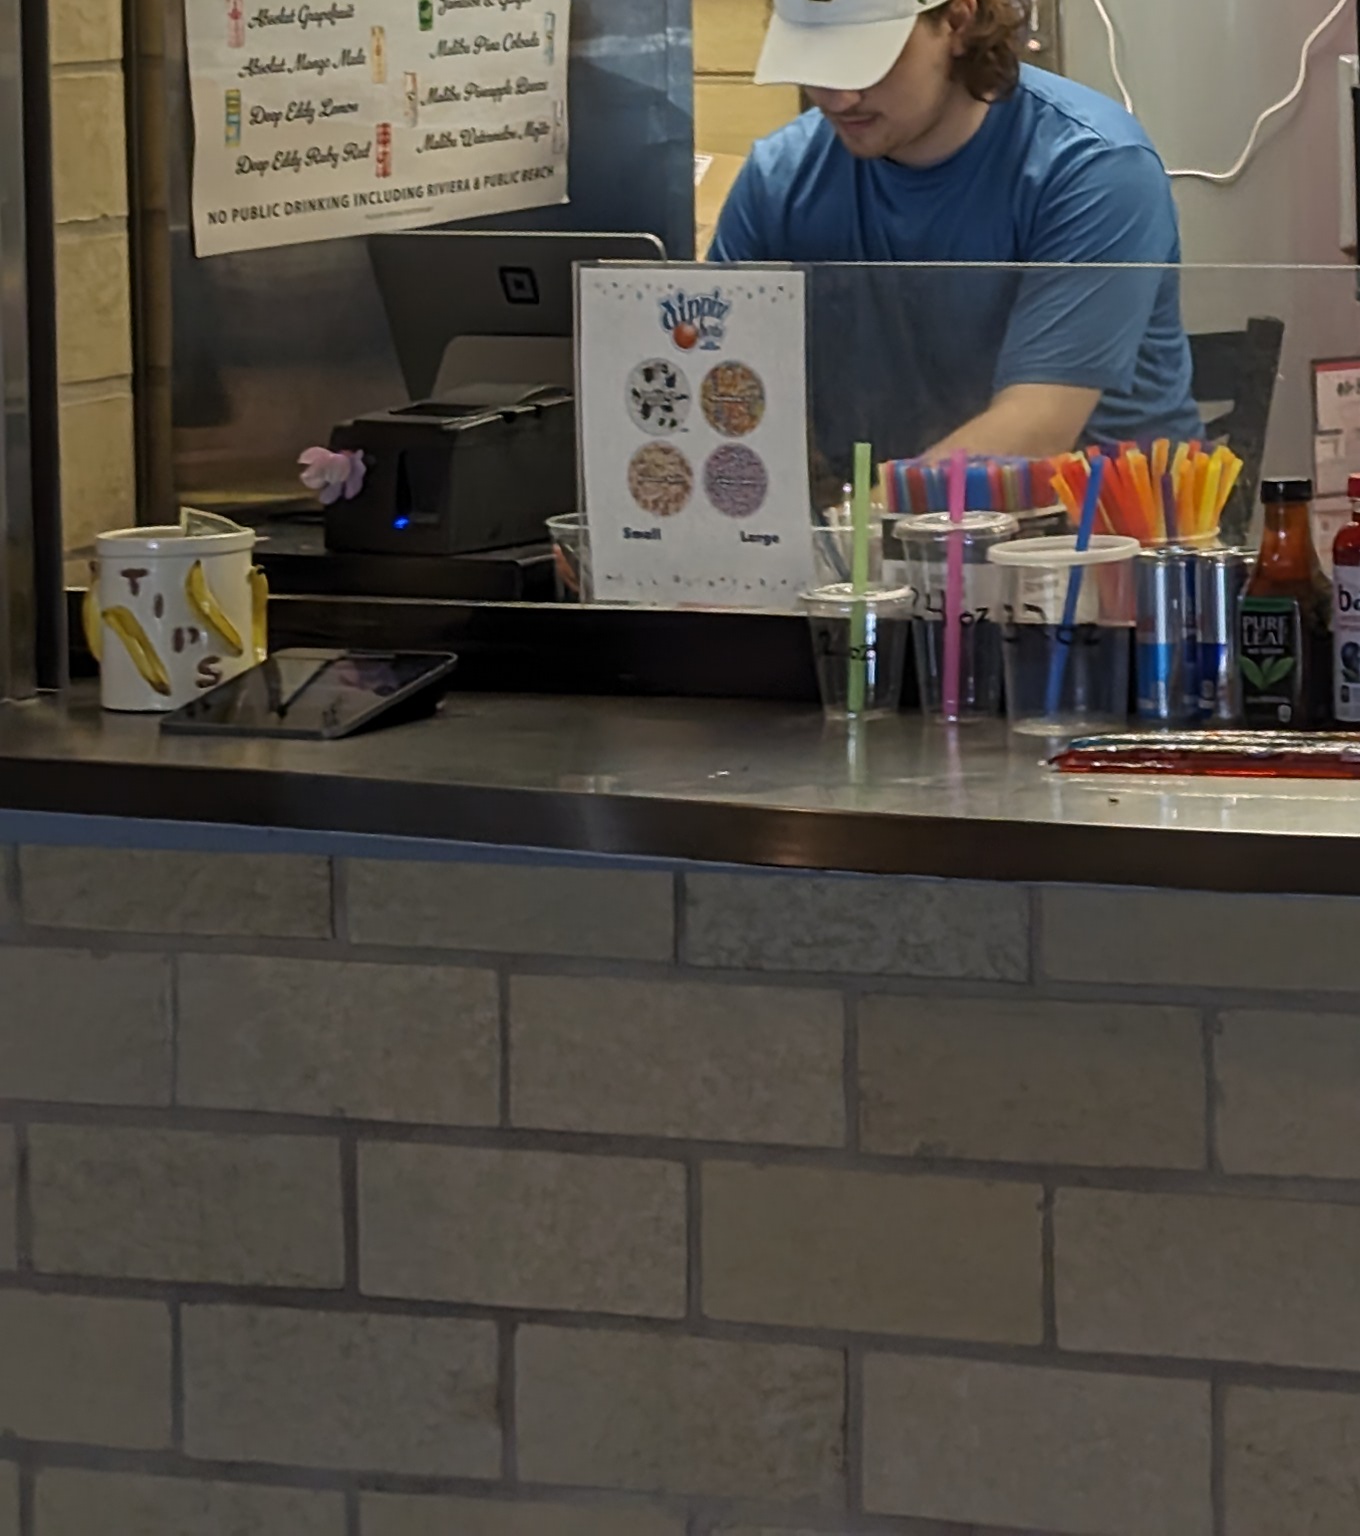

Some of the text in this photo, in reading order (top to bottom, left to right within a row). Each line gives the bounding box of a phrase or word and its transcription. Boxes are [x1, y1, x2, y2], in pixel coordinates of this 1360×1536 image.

[207, 209, 228, 226] NO
[231, 202, 280, 222] PUBLIC
[283, 194, 351, 217] DRINKING
[353, 186, 424, 207] INCLUDING
[427, 179, 471, 199] RIVIERA
[483, 172, 519, 190] PUBLIC
[521, 165, 555, 183] BEACH
[1243, 616, 1286, 629] PURE
[1243, 630, 1284, 645] LEAF
